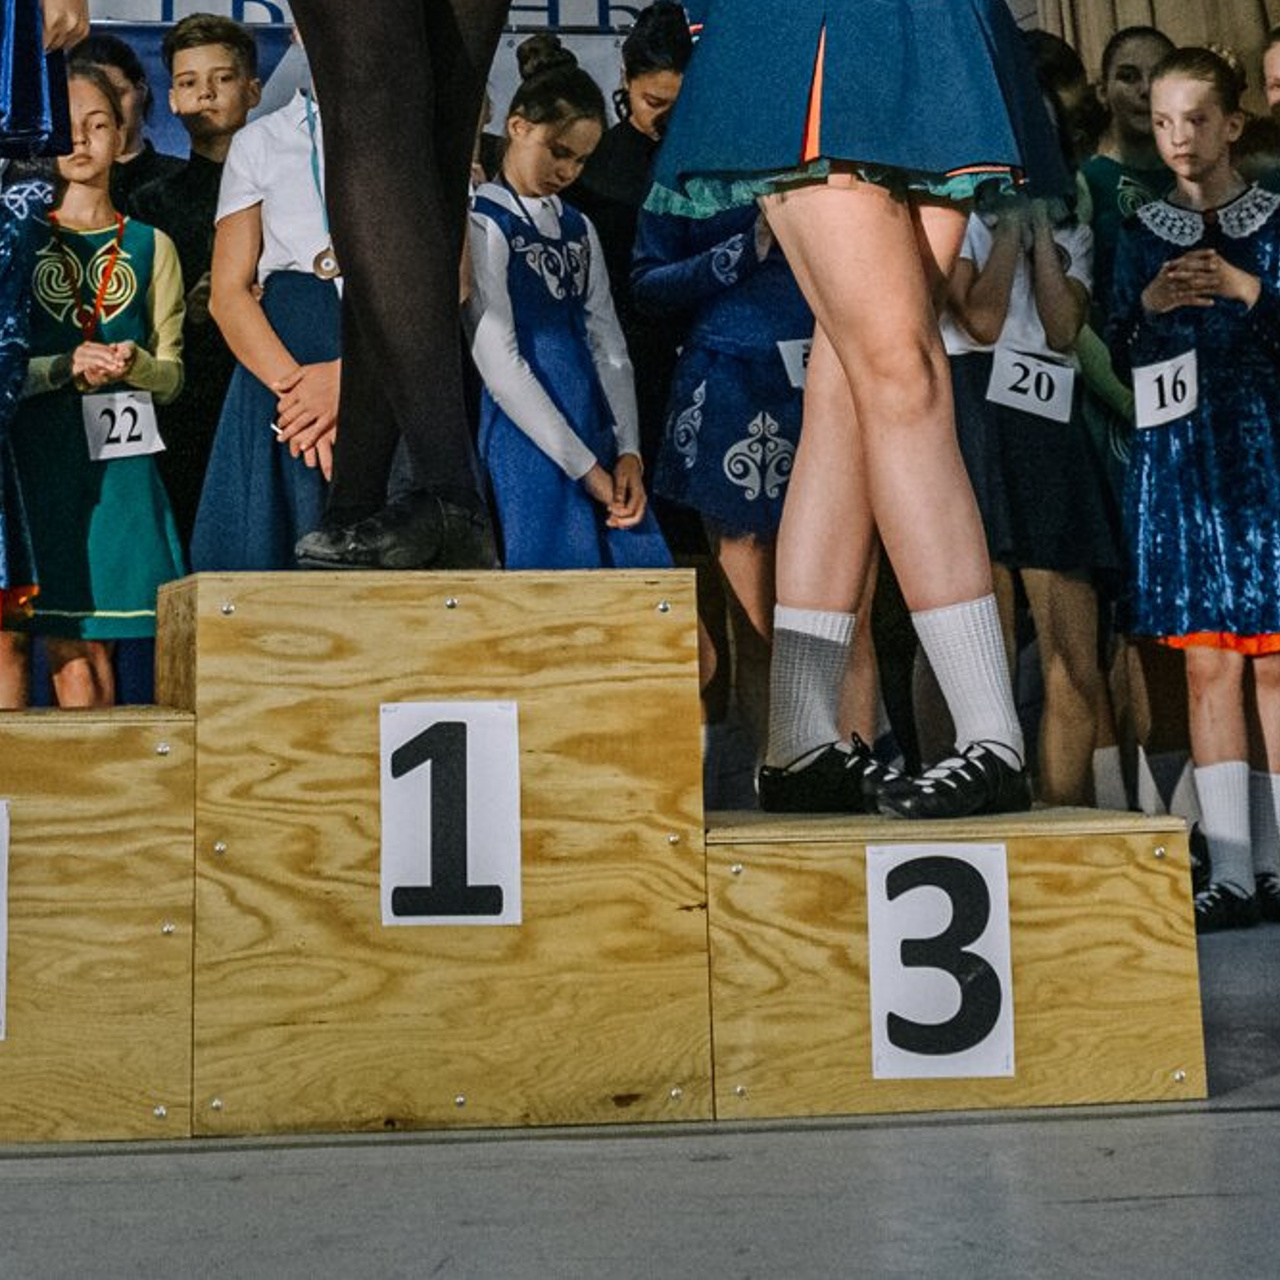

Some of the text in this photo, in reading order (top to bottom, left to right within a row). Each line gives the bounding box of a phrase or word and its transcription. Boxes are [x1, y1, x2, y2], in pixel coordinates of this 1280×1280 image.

[1007, 362, 1055, 402] 20
[1154, 365, 1187, 410] 16
[99, 406, 143, 444] 22
[391, 721, 503, 916] 1
[885, 855, 1003, 1056] 3
